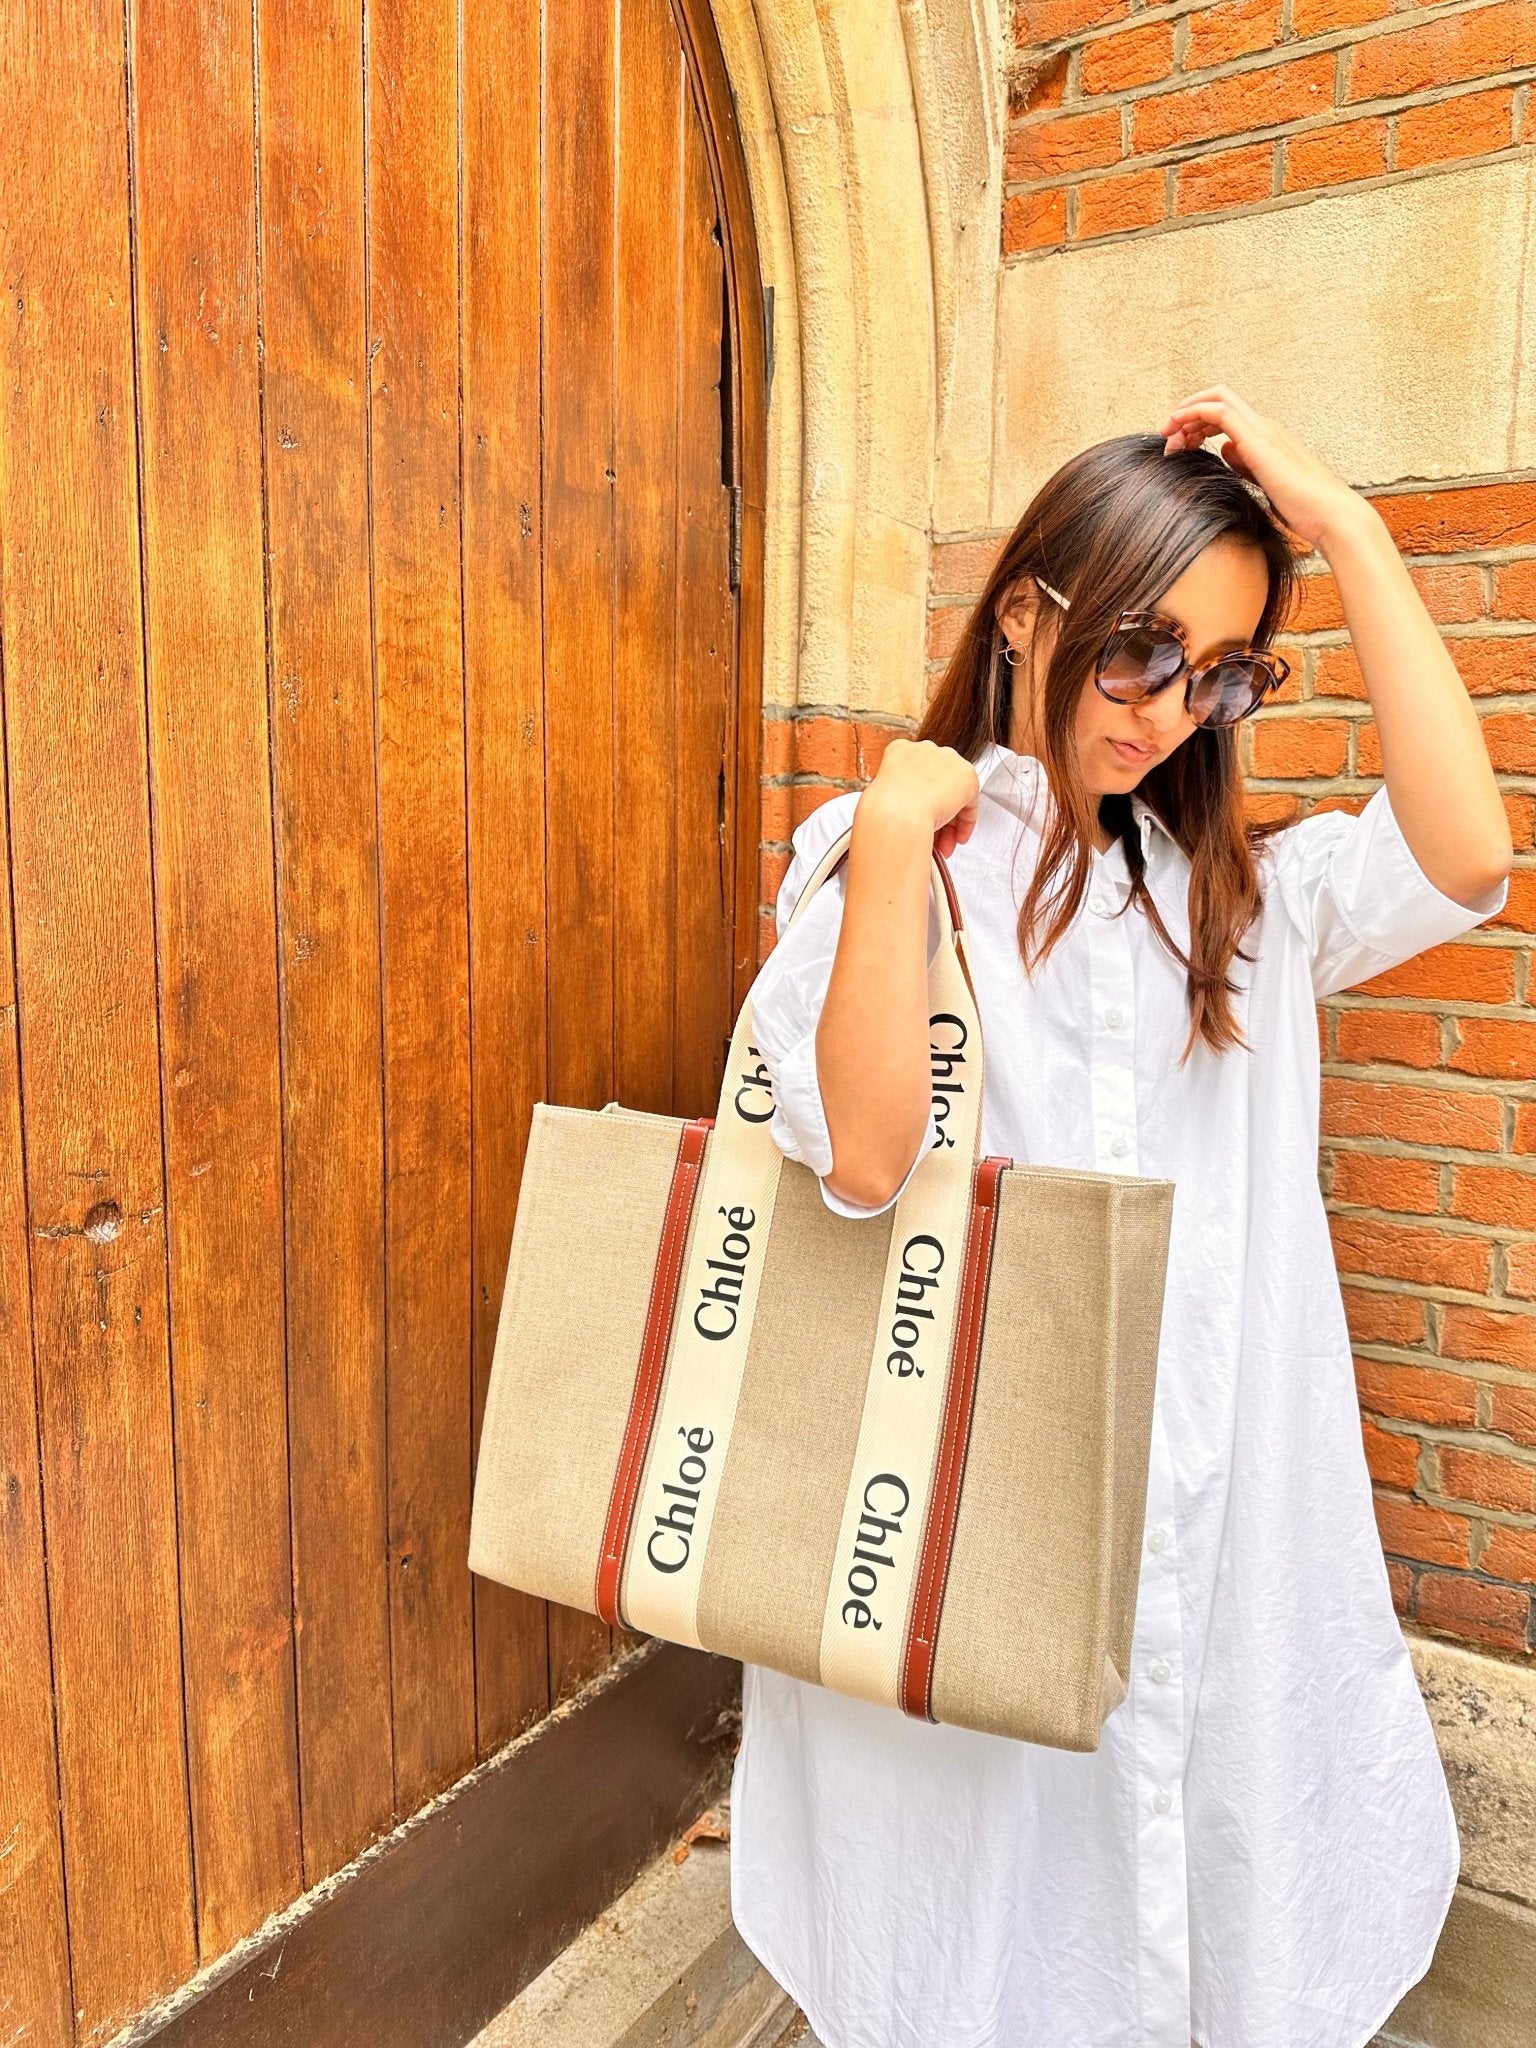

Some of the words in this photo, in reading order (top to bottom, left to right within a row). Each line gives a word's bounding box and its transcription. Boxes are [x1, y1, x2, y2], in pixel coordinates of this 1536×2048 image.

[693, 1206, 756, 1341] Chloé
[886, 1234, 945, 1378] Chloé
[647, 1427, 714, 1574] Chloé
[842, 1473, 910, 1631] Chloé
